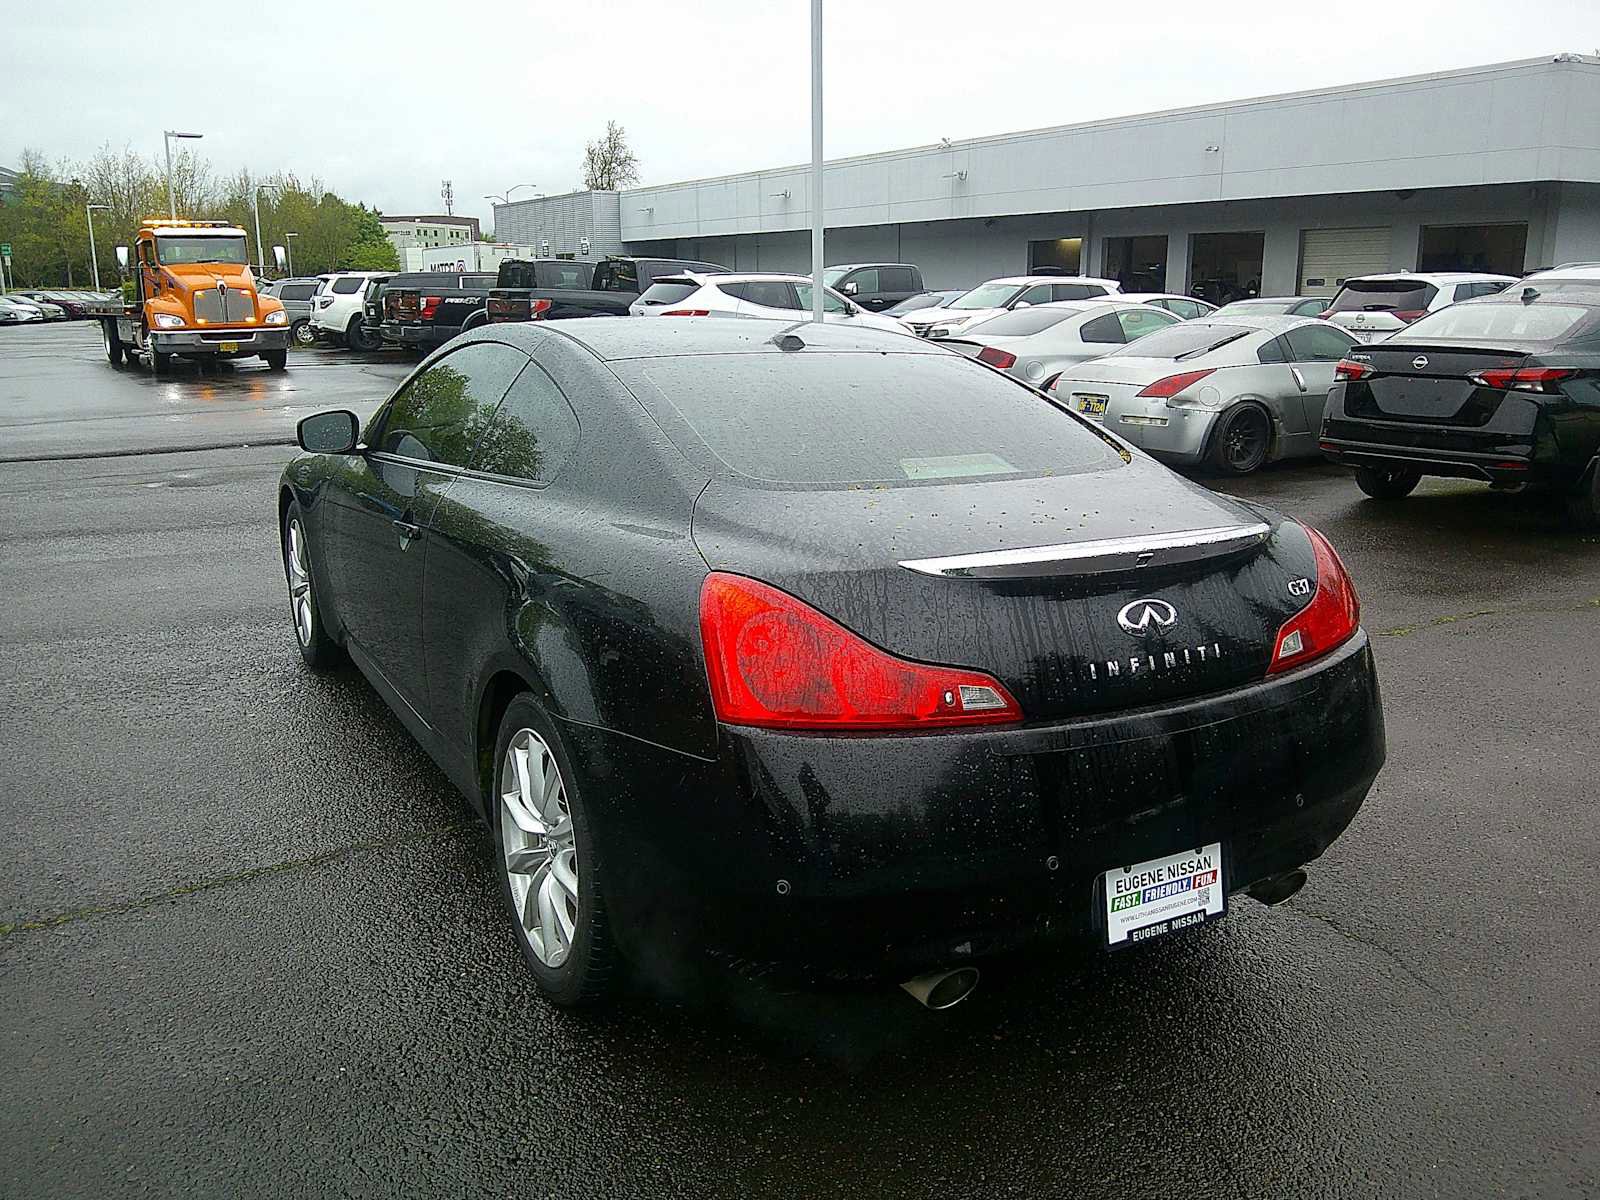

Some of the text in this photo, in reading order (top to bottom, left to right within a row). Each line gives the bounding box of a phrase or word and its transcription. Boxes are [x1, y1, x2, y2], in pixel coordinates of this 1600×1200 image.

[1287, 578, 1310, 595] G37
[1089, 643, 1221, 680] INFINITI
[1113, 872, 1216, 911] FAST. FRIENDLY. FUN.
[1115, 856, 1212, 894] EUGENE NISSAN
[1132, 911, 1205, 942] EUGENE NISSAN
